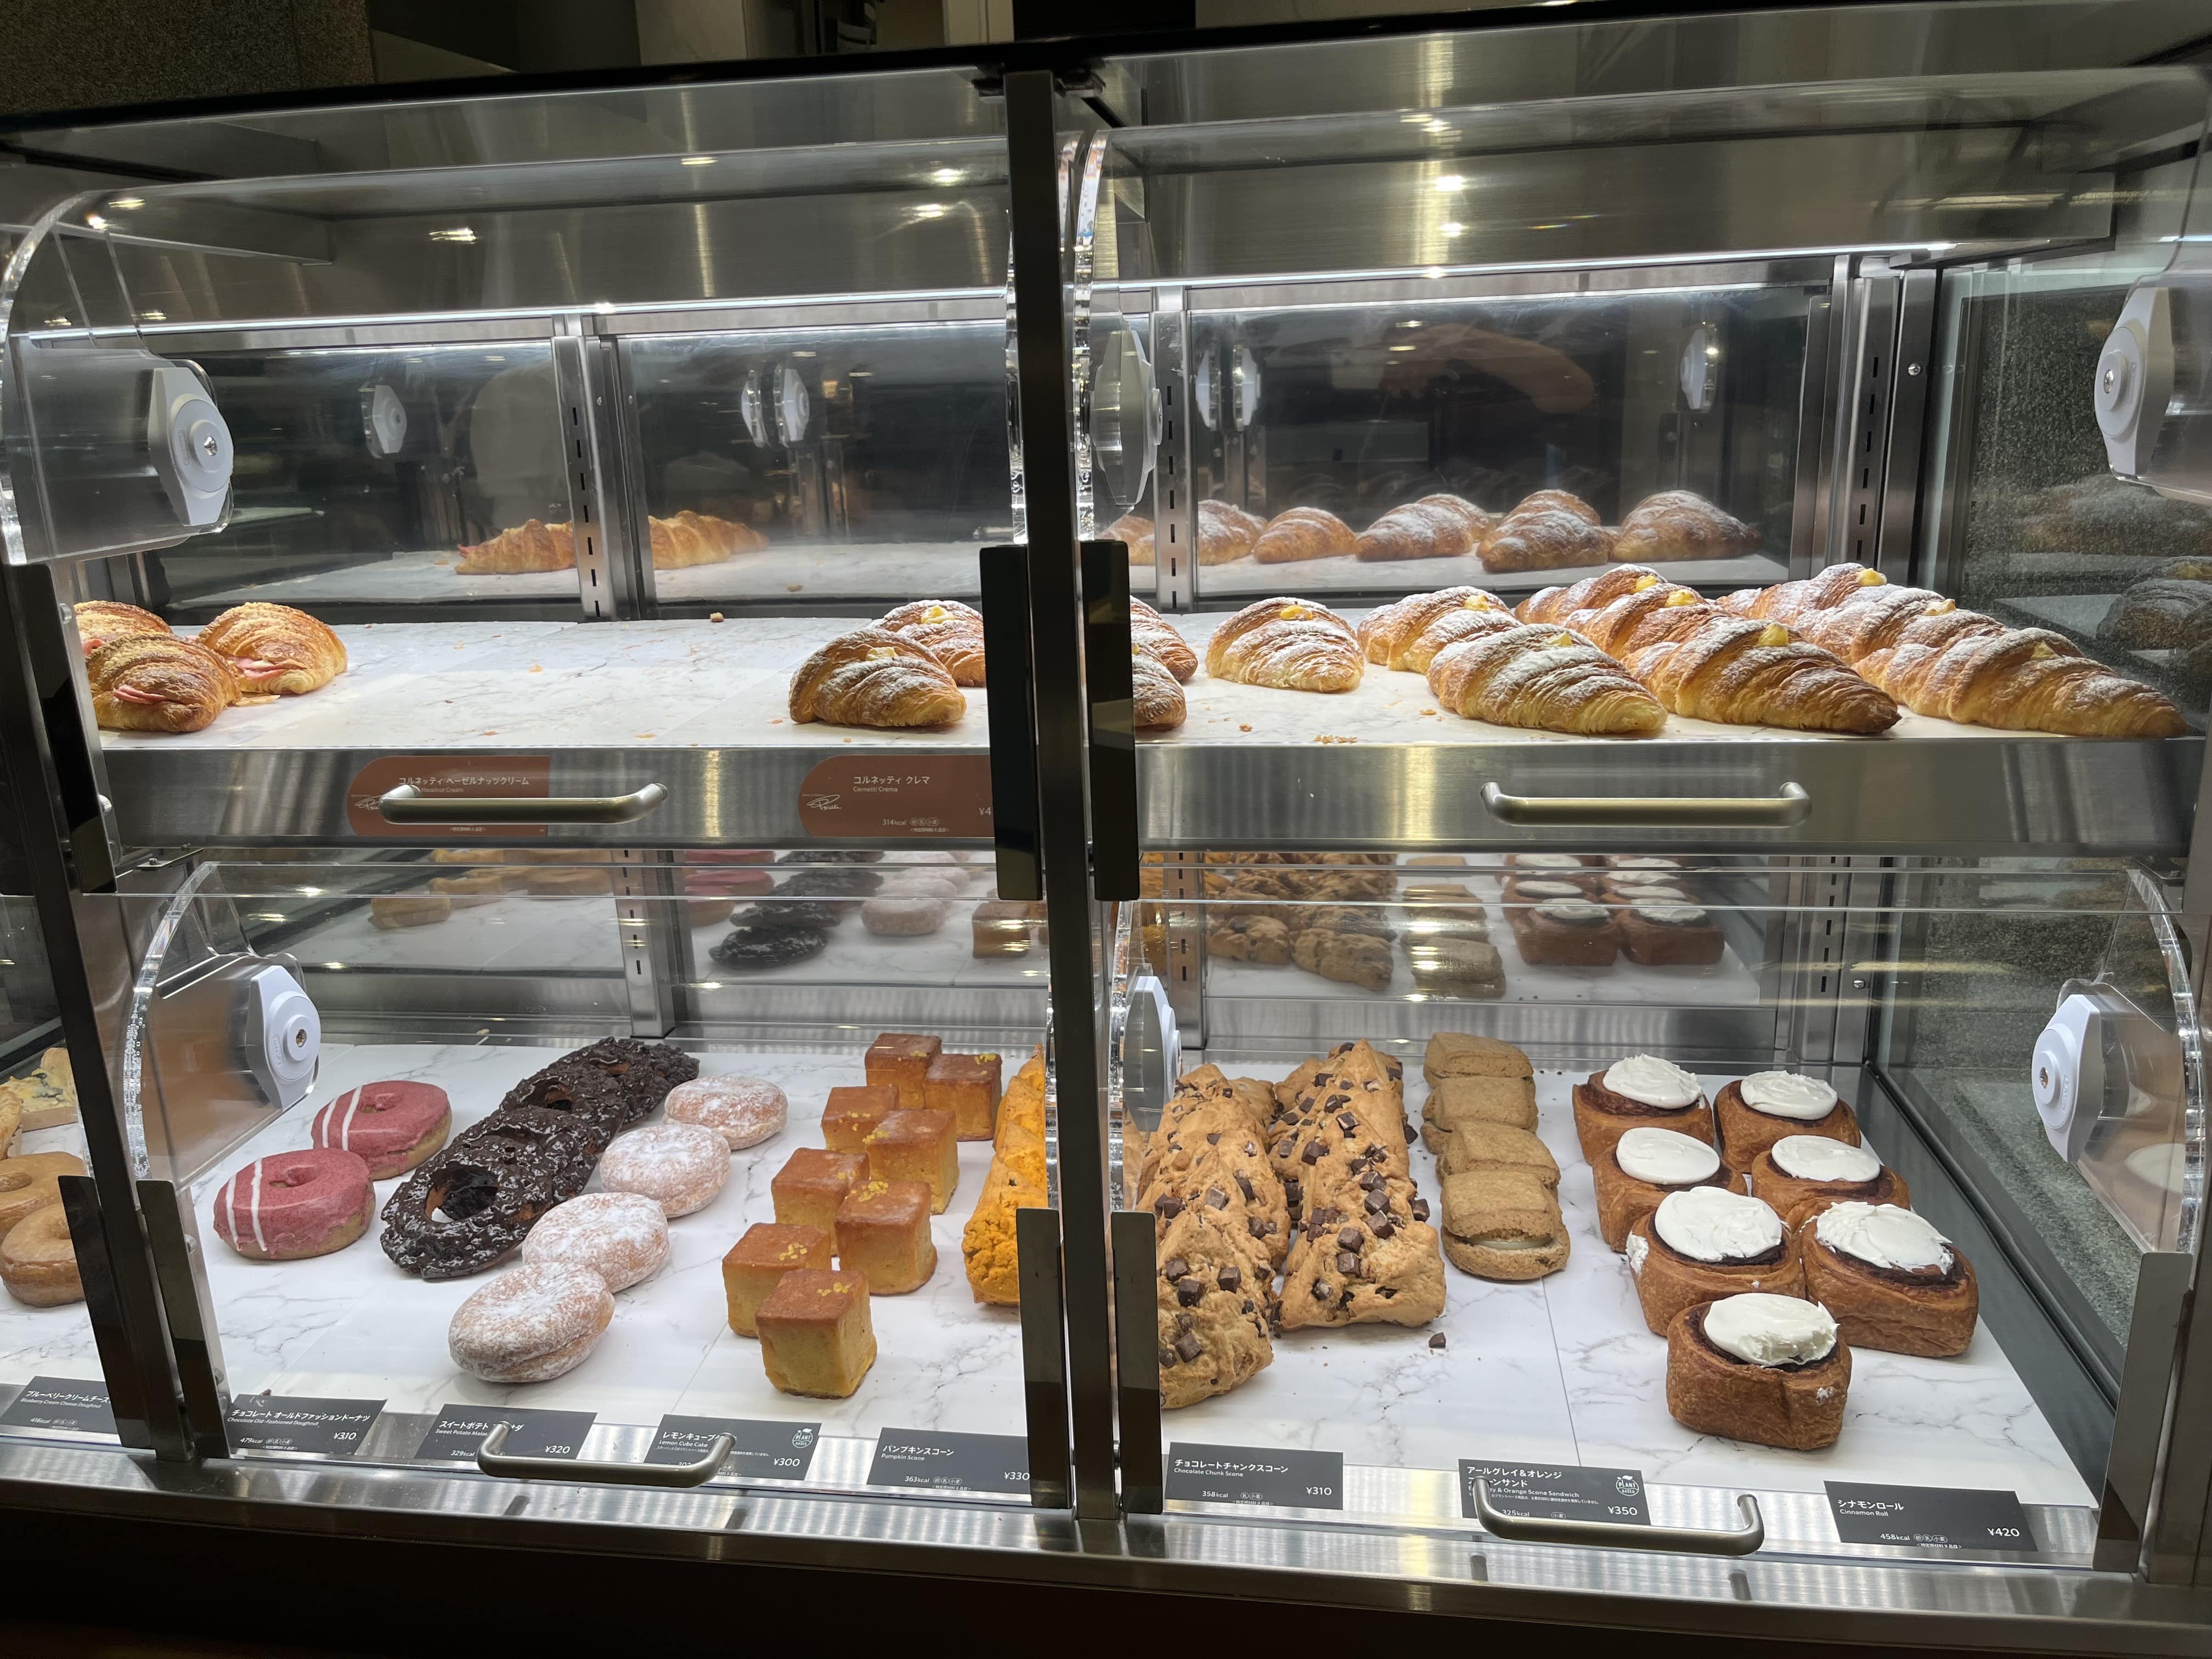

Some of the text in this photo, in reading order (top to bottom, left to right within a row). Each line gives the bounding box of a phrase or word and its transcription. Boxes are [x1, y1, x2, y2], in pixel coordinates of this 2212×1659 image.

[399, 777, 529, 785] コルネッティ ヘーゼルナッツクリーム
[854, 776, 930, 785] コルネッティ クレマ
[979, 806, 992, 816] ¥4
[232, 1409, 370, 1422] チョコレート オールドファッションドーナツ
[439, 1421, 489, 1430] スイートポテト
[334, 1432, 357, 1440] ¥310
[545, 1445, 571, 1454] ¥320
[882, 1445, 954, 1457] パンプキンスコーン
[774, 1458, 800, 1466] ¥300
[1175, 1459, 1289, 1473] チョコレートチャンクスコーン
[1004, 1471, 1030, 1480] ¥330
[1467, 1466, 1562, 1479] アールグレイ&オレンジ
[1618, 1480, 1636, 1488] PLANT
[1306, 1486, 1333, 1496] ¥310
[1838, 1499, 1904, 1510] シナモンロール
[1607, 1506, 1638, 1516] ¥350
[1987, 1528, 2020, 1537] ¥420
